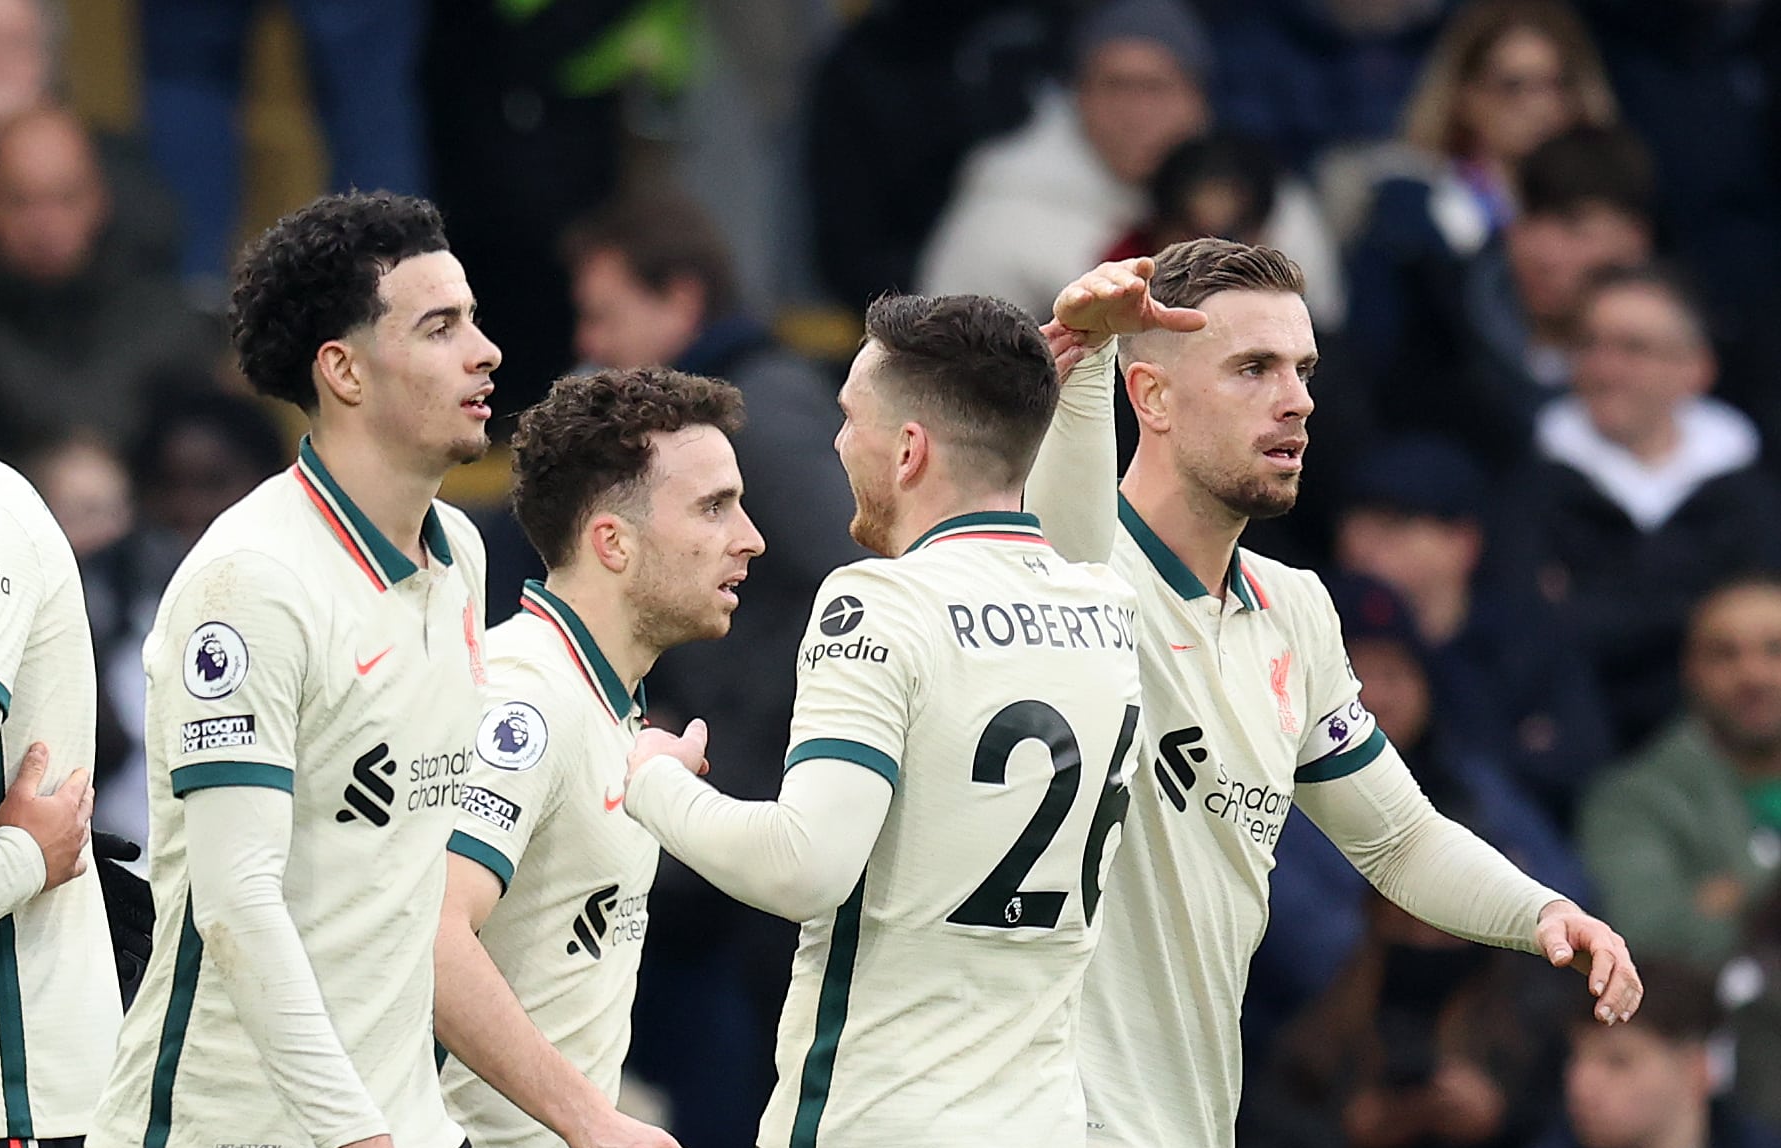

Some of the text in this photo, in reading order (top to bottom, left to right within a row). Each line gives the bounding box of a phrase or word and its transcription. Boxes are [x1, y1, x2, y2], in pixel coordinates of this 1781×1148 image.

[181, 717, 248, 741] No room
[181, 731, 256, 754] for racism
[464, 799, 515, 834] racism
[470, 788, 514, 818] room
